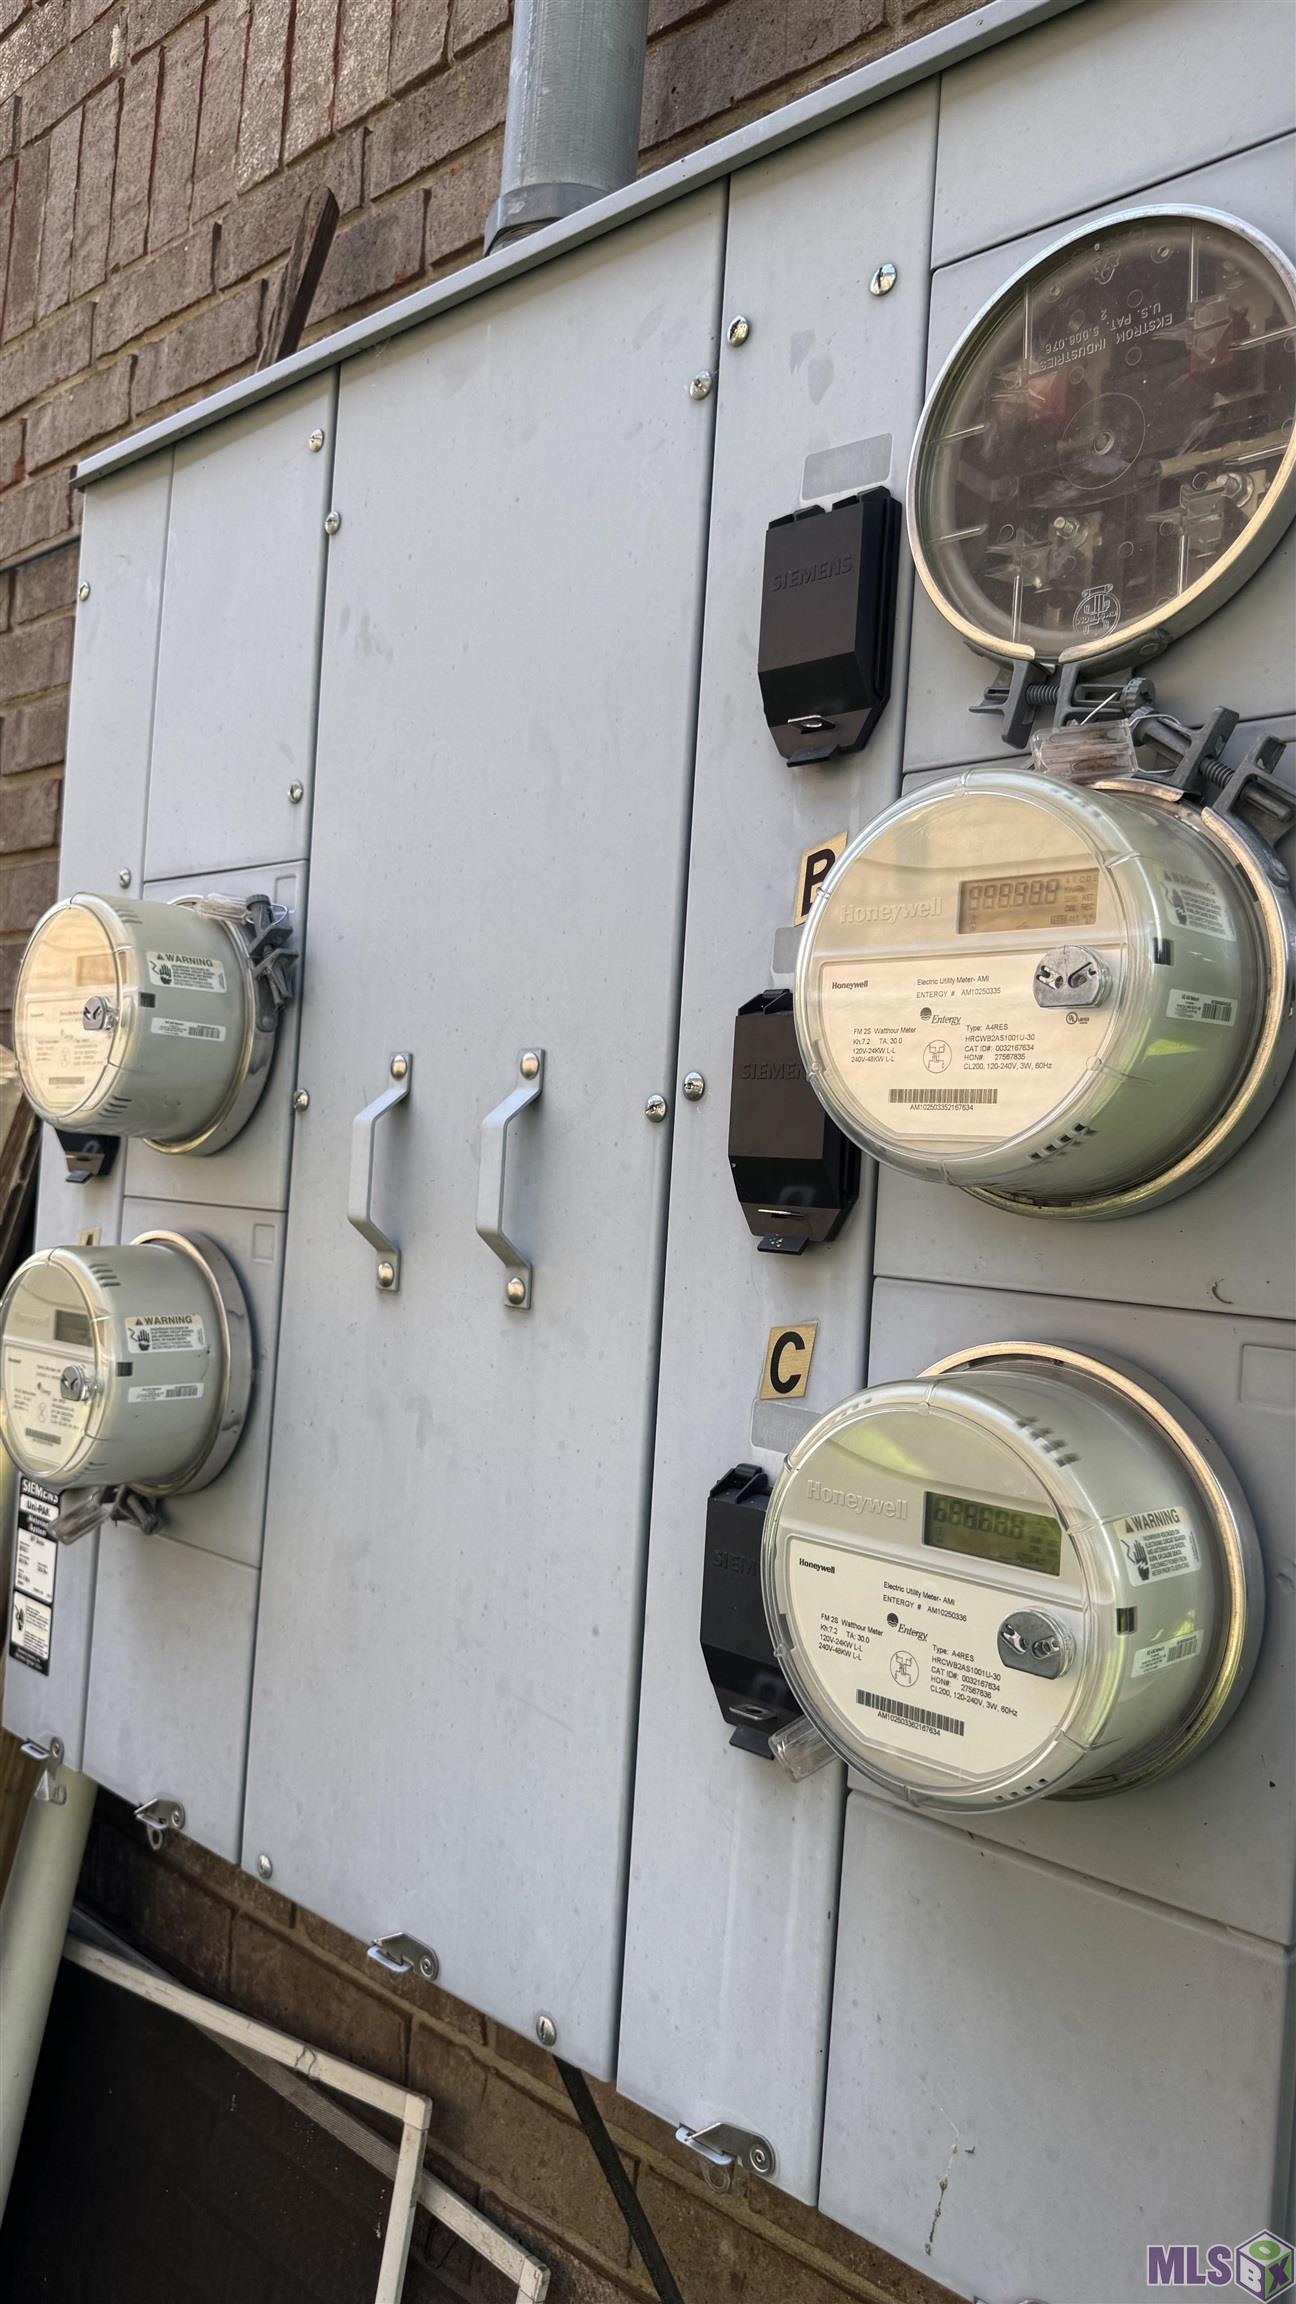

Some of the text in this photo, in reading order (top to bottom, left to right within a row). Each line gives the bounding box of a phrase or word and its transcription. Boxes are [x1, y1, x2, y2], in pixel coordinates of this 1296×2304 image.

[1137, 302, 1161, 319] U.S.
[1106, 313, 1132, 331] PAT.
[1039, 312, 1173, 371] EKSTROM INDUSTRIES
[770, 556, 853, 592] SIEMENS
[840, 897, 943, 924] Honeywell
[165, 953, 213, 967] WARNING
[832, 980, 869, 990] Honeywell
[917, 978, 938, 986] Electric
[940, 977, 955, 986] Utility
[977, 975, 990, 983] AMI
[916, 990, 948, 999] ENTERGY
[931, 1014, 961, 1026] Entergy
[985, 1023, 1009, 1031] A4RES
[900, 1026, 917, 1034] Meter
[964, 1045, 979, 1053] CAT
[741, 1063, 806, 1080] SIEMEN
[144, 1315, 193, 1326] WARNING
[770, 1331, 805, 1394] C
[807, 1479, 908, 1520] Honeywell
[1131, 1508, 1181, 1532] WARNING
[711, 1549, 758, 1577] SIEM
[799, 1557, 836, 1574] Honeywell
[883, 1581, 904, 1593] Electric
[905, 1587, 921, 1598] Utility
[942, 1596, 956, 1606] AMI
[882, 1594, 915, 1608] ENTERGY
[927, 1605, 968, 1622] AM10250336
[820, 1612, 884, 1636] FM 2S Watthour Meter
[898, 1623, 928, 1641] Entergy
[857, 1634, 870, 1644] 30.0
[852, 1651, 862, 1661] L-L
[853, 1643, 863, 1653] L-L
[951, 1650, 975, 1662] A4RES
[930, 1665, 945, 1676] CAT
[930, 1684, 1018, 1717] CL200, 120-240V, 3W, 60Hz
